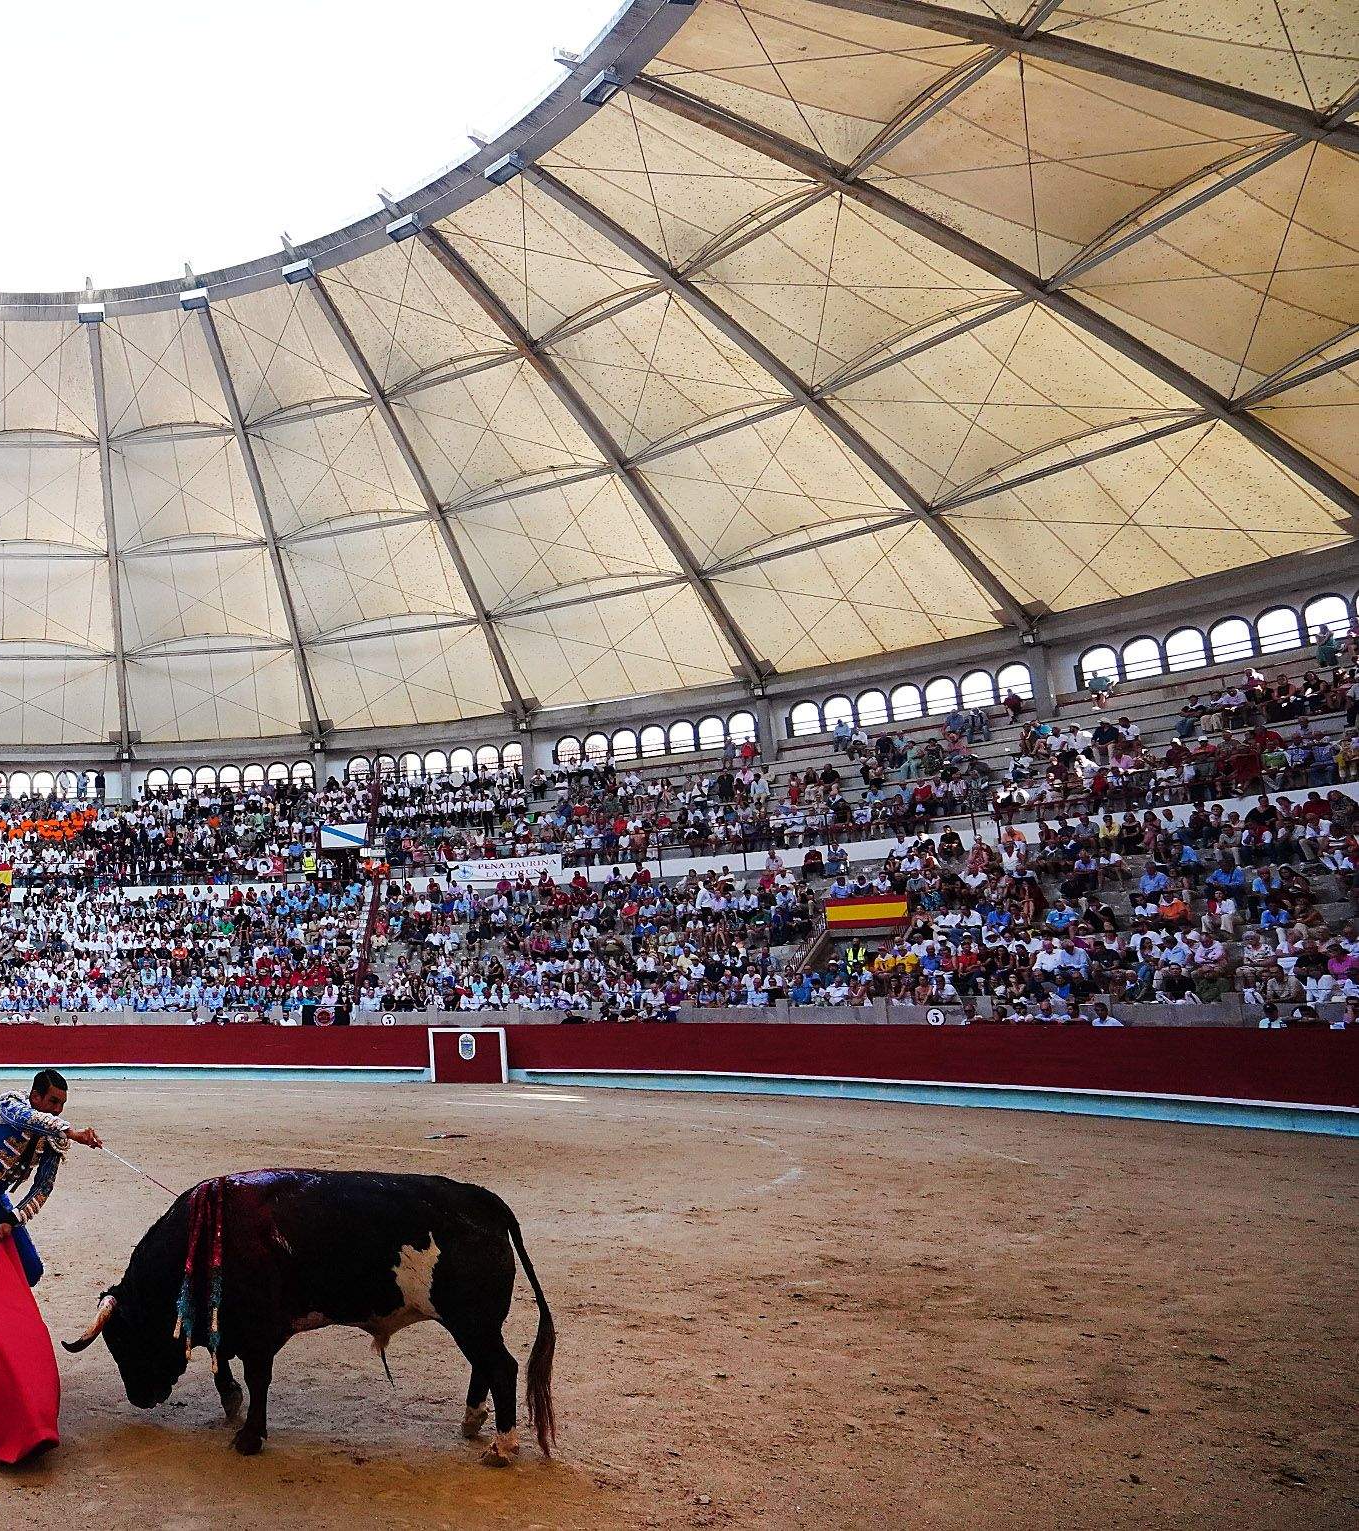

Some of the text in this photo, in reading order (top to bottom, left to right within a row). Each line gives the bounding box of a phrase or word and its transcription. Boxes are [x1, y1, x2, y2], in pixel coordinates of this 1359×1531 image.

[509, 858, 557, 869] TAURINA
[486, 869, 499, 878] LA
[932, 1012, 940, 1023] 5
